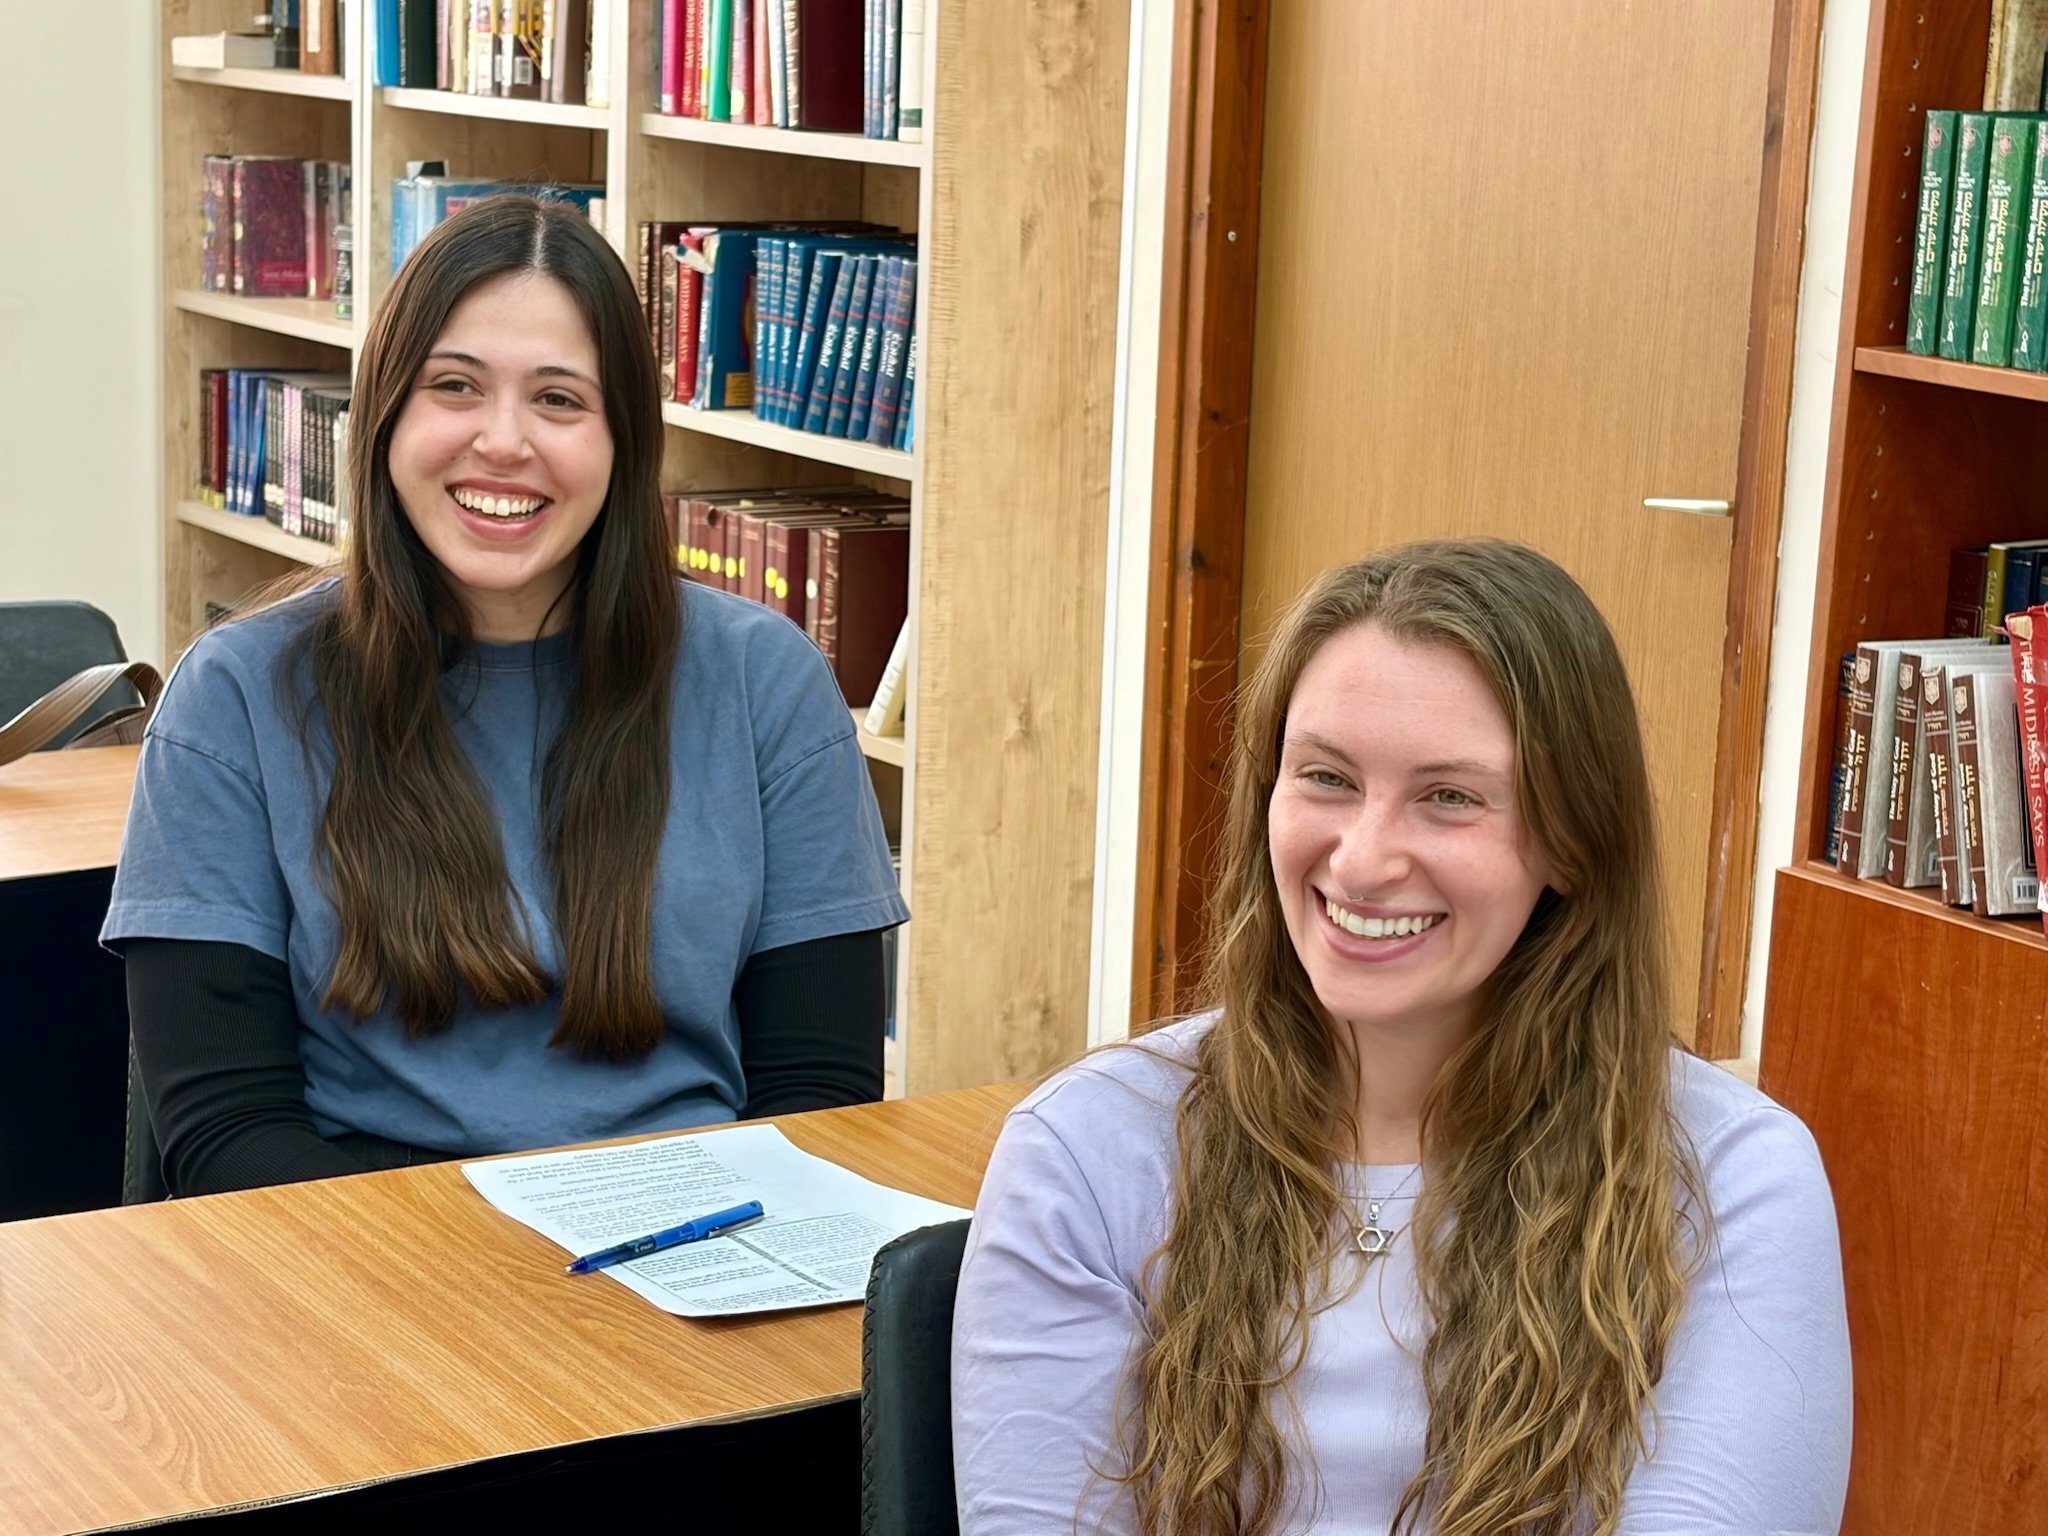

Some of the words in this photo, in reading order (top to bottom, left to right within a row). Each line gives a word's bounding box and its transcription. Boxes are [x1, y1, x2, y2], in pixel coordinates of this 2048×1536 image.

[1920, 214, 1928, 232] the
[1988, 223, 1996, 241] the
[1918, 234, 1926, 246] of
[1952, 235, 1958, 248] of
[1986, 244, 1993, 256] of
[2026, 244, 2033, 257] of
[1916, 249, 1924, 274] Path
[1949, 250, 1957, 275] Path
[1983, 259, 1993, 284] Path
[2022, 260, 2032, 285] Path
[1914, 276, 1922, 295] The
[1947, 277, 1955, 296] The
[680, 278, 691, 333] MIDRASH
[1982, 286, 1991, 306] The
[2021, 287, 2030, 306] The
[679, 335, 690, 362] SAYS
[1848, 728, 1856, 752] God
[1856, 734, 1865, 753] דרך
[1846, 754, 1853, 766] of
[1901, 741, 1910, 760] דרך
[1893, 762, 1899, 774] of
[1938, 755, 1947, 775] דרך
[2022, 688, 2040, 789] MIDRASH
[2031, 795, 2045, 848] SAYS
[1845, 768, 1854, 791] Way
[1966, 765, 1975, 785] דרך
[1932, 779, 1938, 791] of
[1933, 793, 1941, 817] Way
